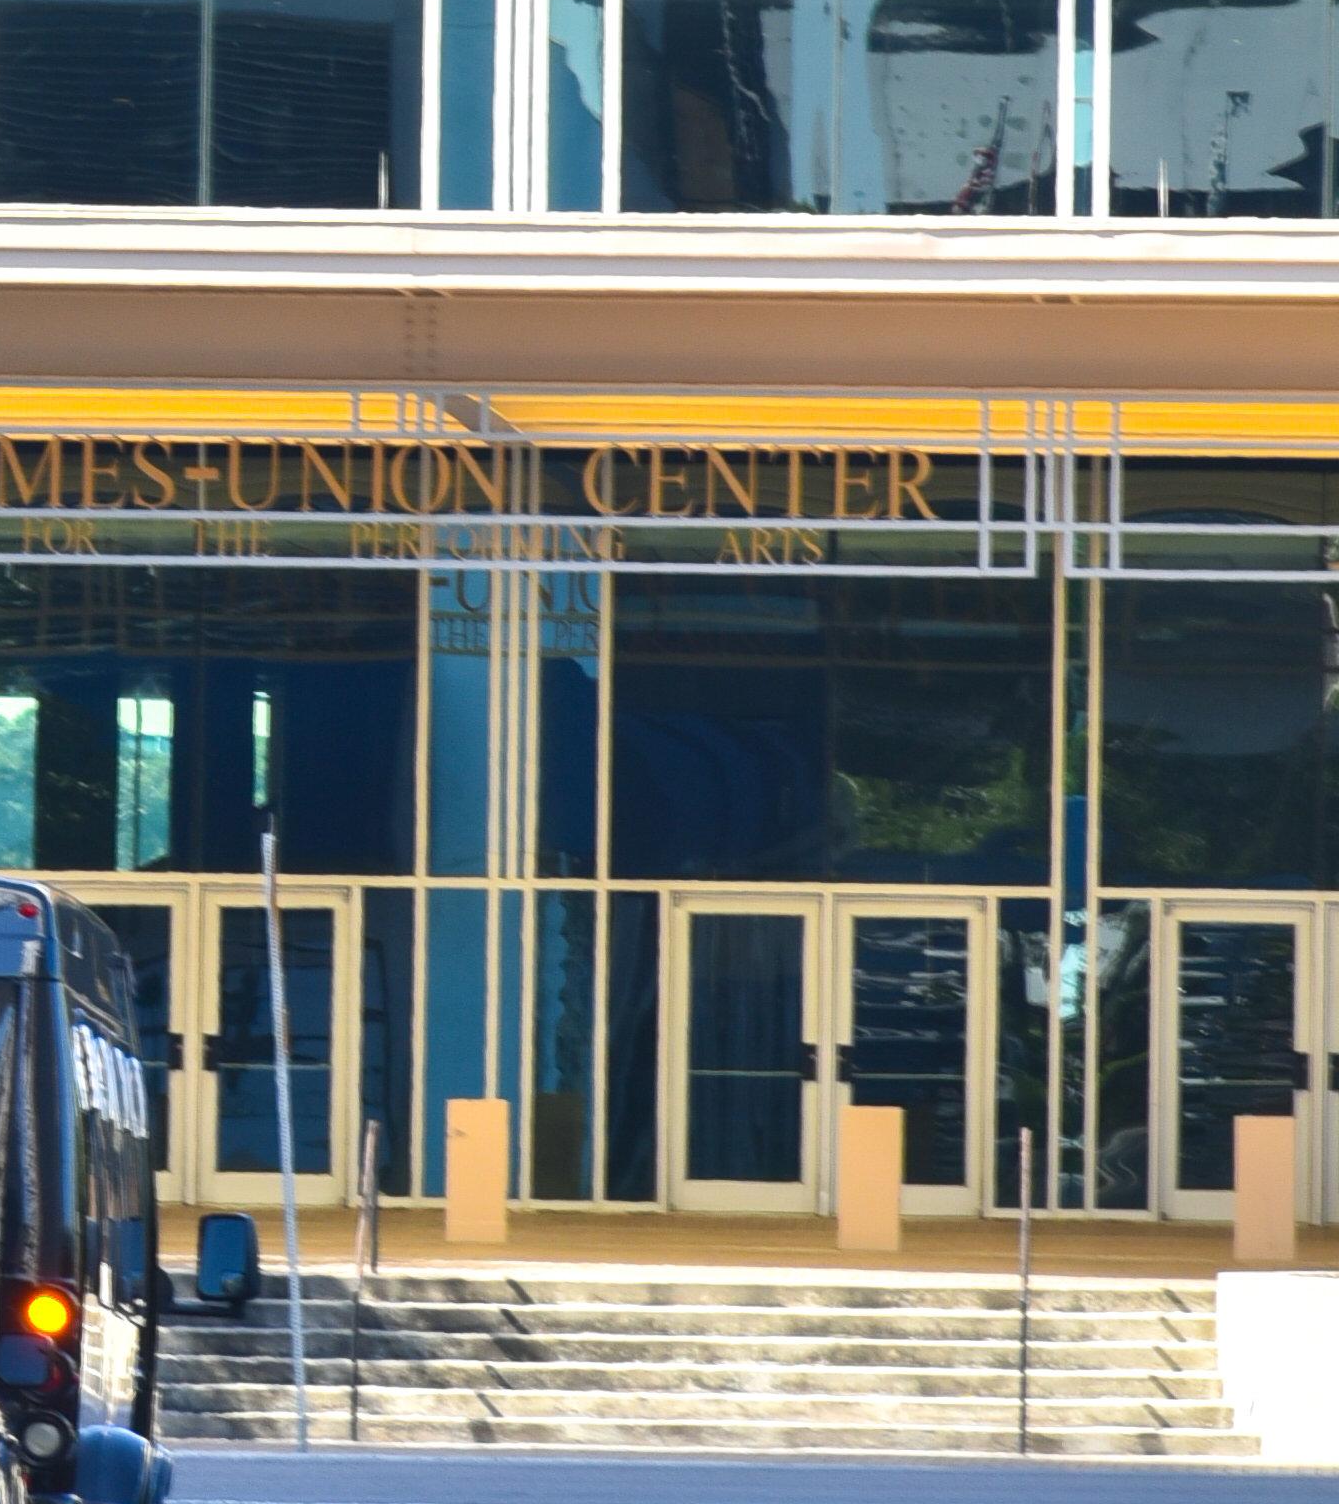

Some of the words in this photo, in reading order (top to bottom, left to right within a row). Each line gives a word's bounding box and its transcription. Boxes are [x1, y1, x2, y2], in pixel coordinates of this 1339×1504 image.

[583, 441, 939, 521] CENTER
[23, 518, 101, 556] FOR
[193, 519, 274, 558] THE
[716, 526, 823, 566] ARTS
